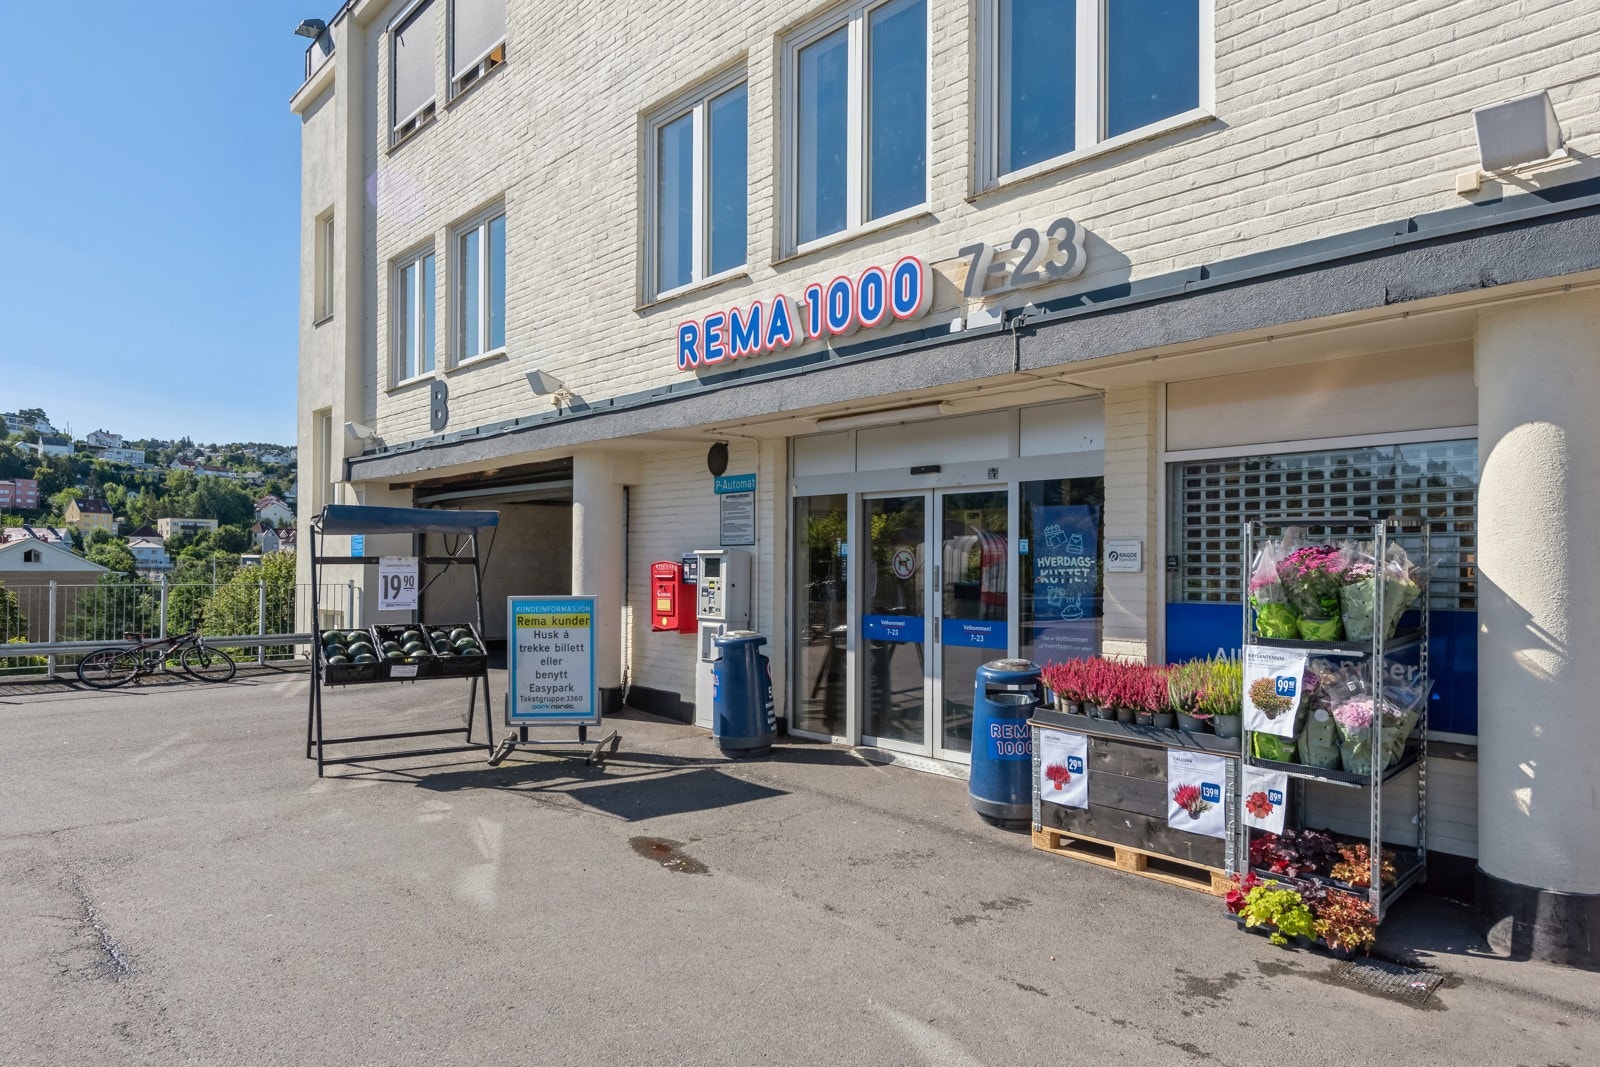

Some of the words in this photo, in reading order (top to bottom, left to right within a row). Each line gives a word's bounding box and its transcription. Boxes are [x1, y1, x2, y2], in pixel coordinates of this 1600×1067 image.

[958, 217, 1078, 298] 7-23
[677, 294, 793, 371] REMA
[804, 256, 924, 339] 1000
[430, 379, 448, 430] B
[715, 478, 756, 491] P-Automat
[1037, 556, 1096, 568] HVERDAGS-
[382, 574, 402, 600] 19
[403, 575, 415, 587] 90
[517, 617, 547, 626] Rema
[552, 616, 591, 626] kunder
[881, 619, 906, 627] Velkommen!
[886, 628, 899, 636] 7-23
[963, 624, 992, 632] Velkommen!
[533, 630, 559, 639] Husk
[563, 630, 570, 639] å
[970, 634, 985, 643] 7-23
[519, 644, 550, 653] trekke
[554, 643, 585, 653] billett
[540, 657, 563, 666] eller
[535, 671, 568, 681] benytt
[529, 684, 574, 694] Easypark
[1277, 679, 1289, 693] 99
[1068, 758, 1078, 771] 29
[1202, 786, 1214, 798] 139
[1269, 791, 1278, 802] 89
